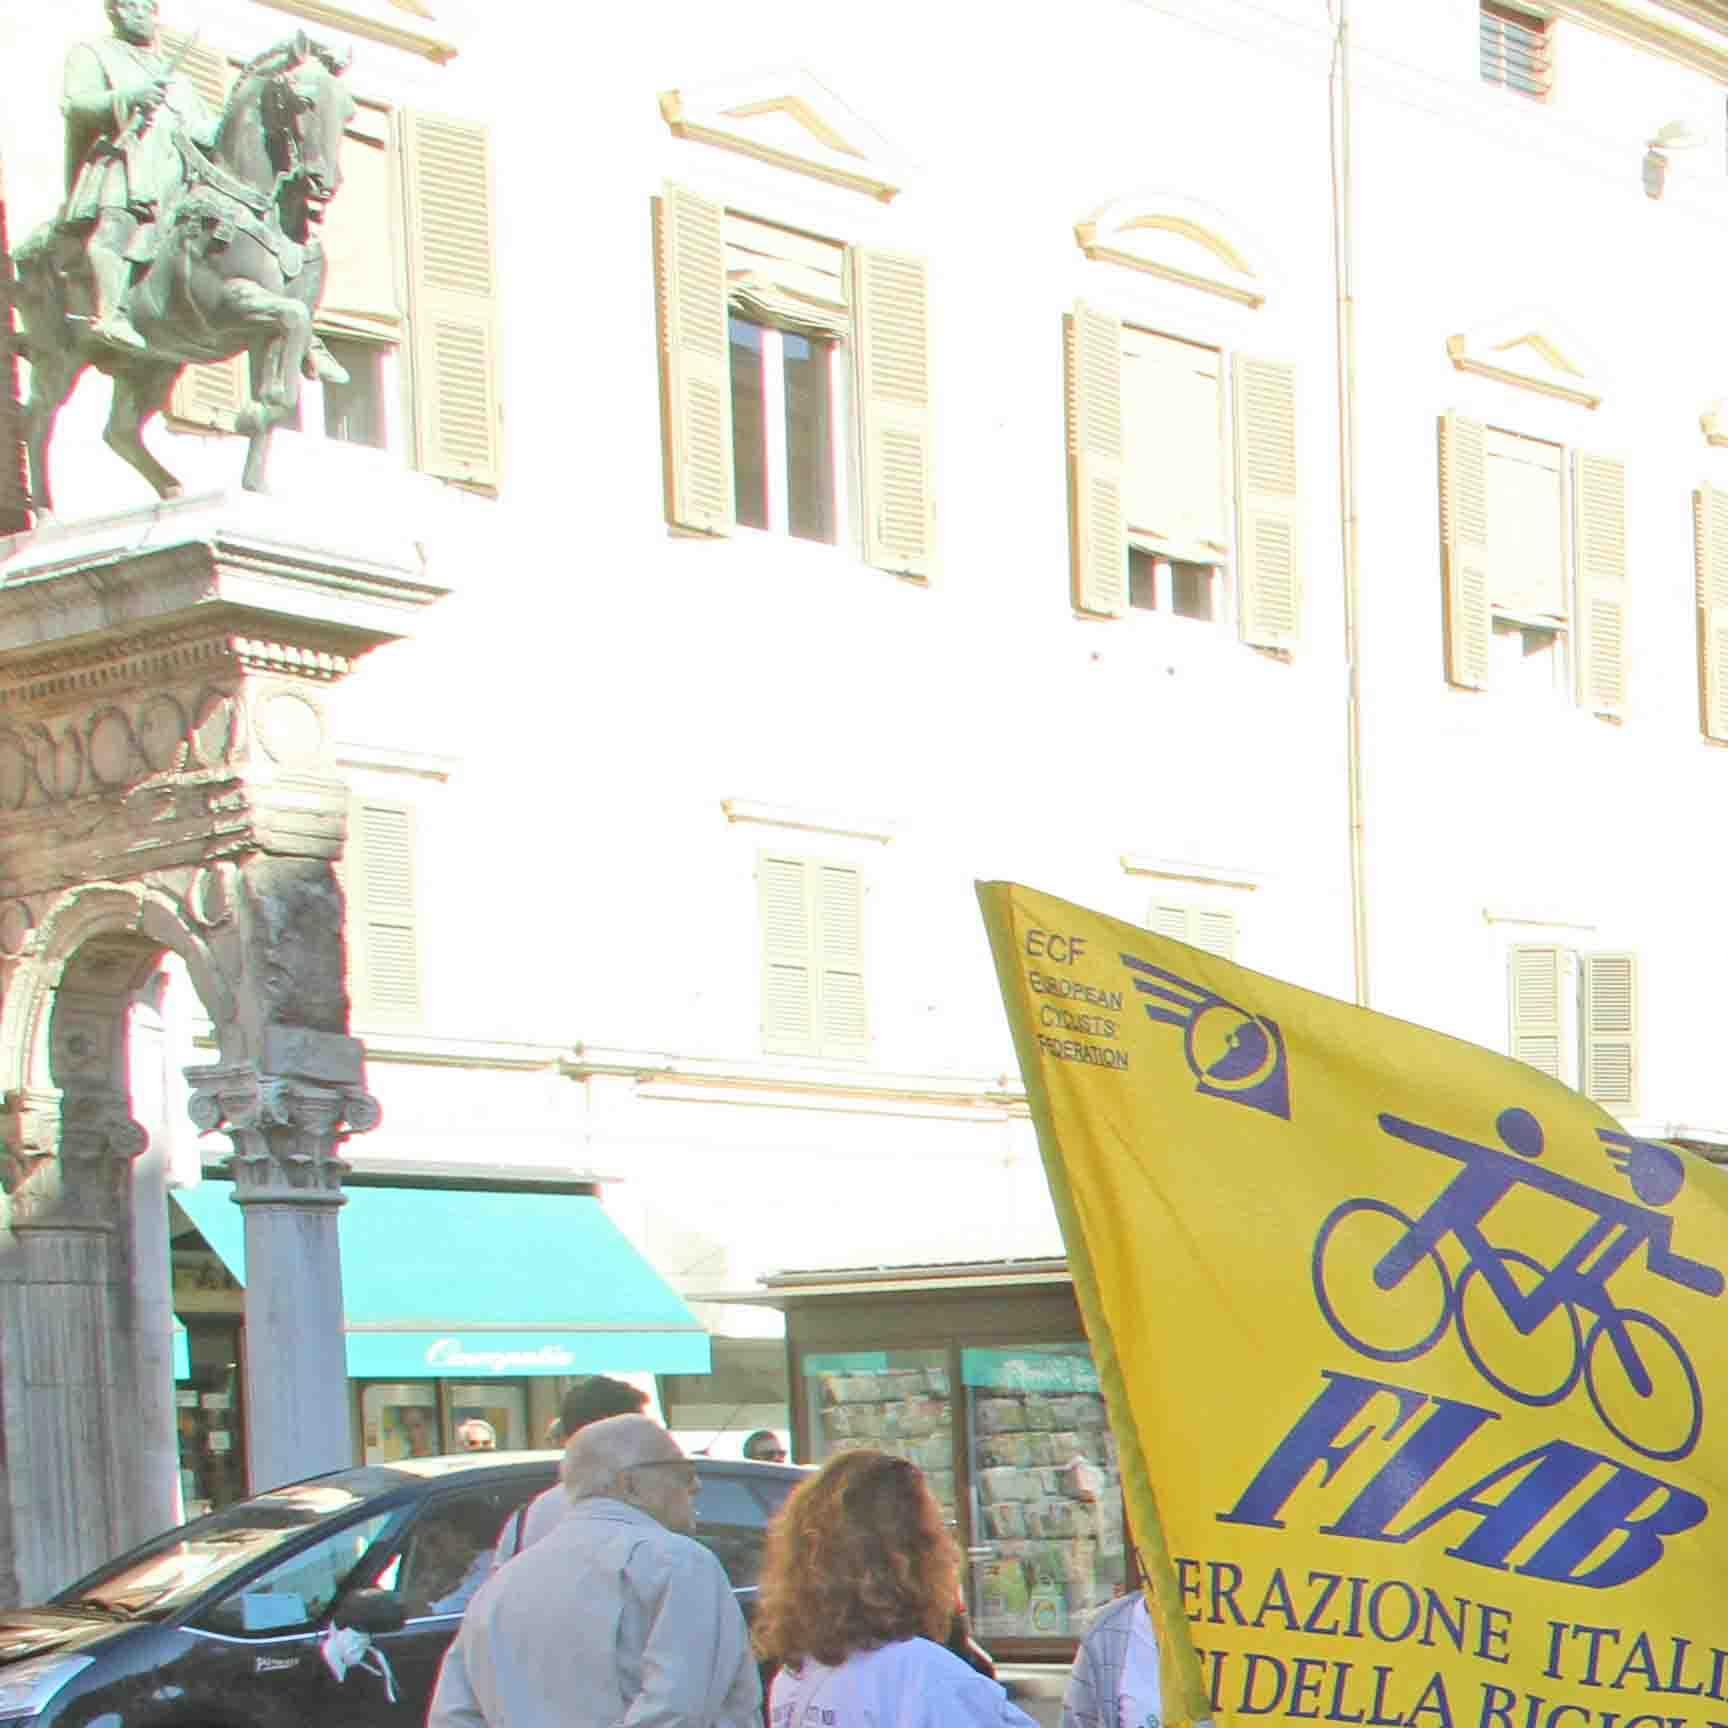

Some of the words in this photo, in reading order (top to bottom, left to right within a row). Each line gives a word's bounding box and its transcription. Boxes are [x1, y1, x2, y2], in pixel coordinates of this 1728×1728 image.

[1026, 929, 1088, 965] ECF
[1029, 971, 1123, 1011] EUROPEAN
[1040, 1005, 1117, 1039] CYCLISTS
[1037, 1034, 1130, 1070] FEDERATION
[1216, 1369, 1709, 1590] FIAB
[1173, 1556, 1512, 1665] ERAZIONE
